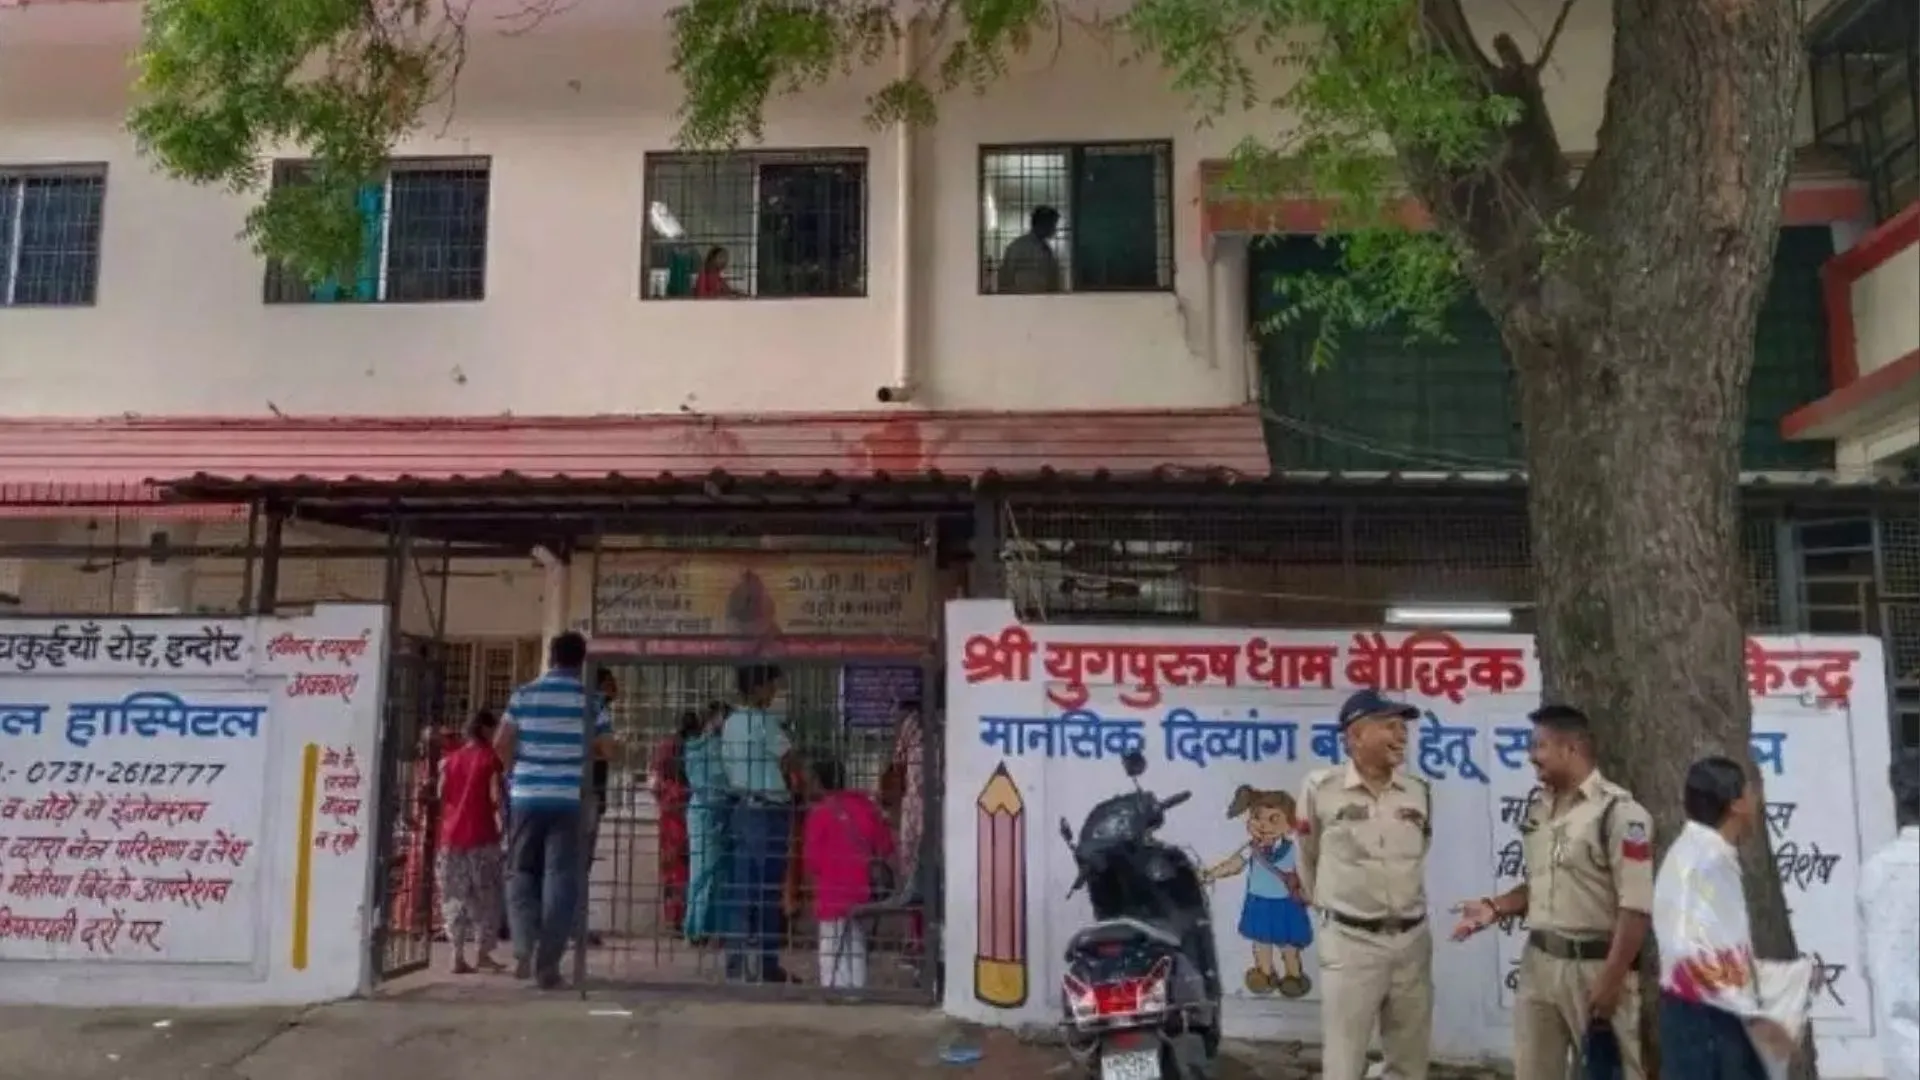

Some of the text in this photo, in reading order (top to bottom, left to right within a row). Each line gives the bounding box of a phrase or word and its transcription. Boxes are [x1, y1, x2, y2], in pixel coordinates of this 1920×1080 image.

[963, 625, 1037, 684] श्री
[1246, 636, 1338, 690] धाम
[1345, 629, 1525, 704] बौद्धिक
[65, 691, 267, 748] हास्पिटल
[979, 708, 1145, 762] मानसिक
[1160, 707, 1299, 769] दिव्यांग
[27, 760, 226, 785] 0731-2612777
[129, 920, 163, 952] पर
